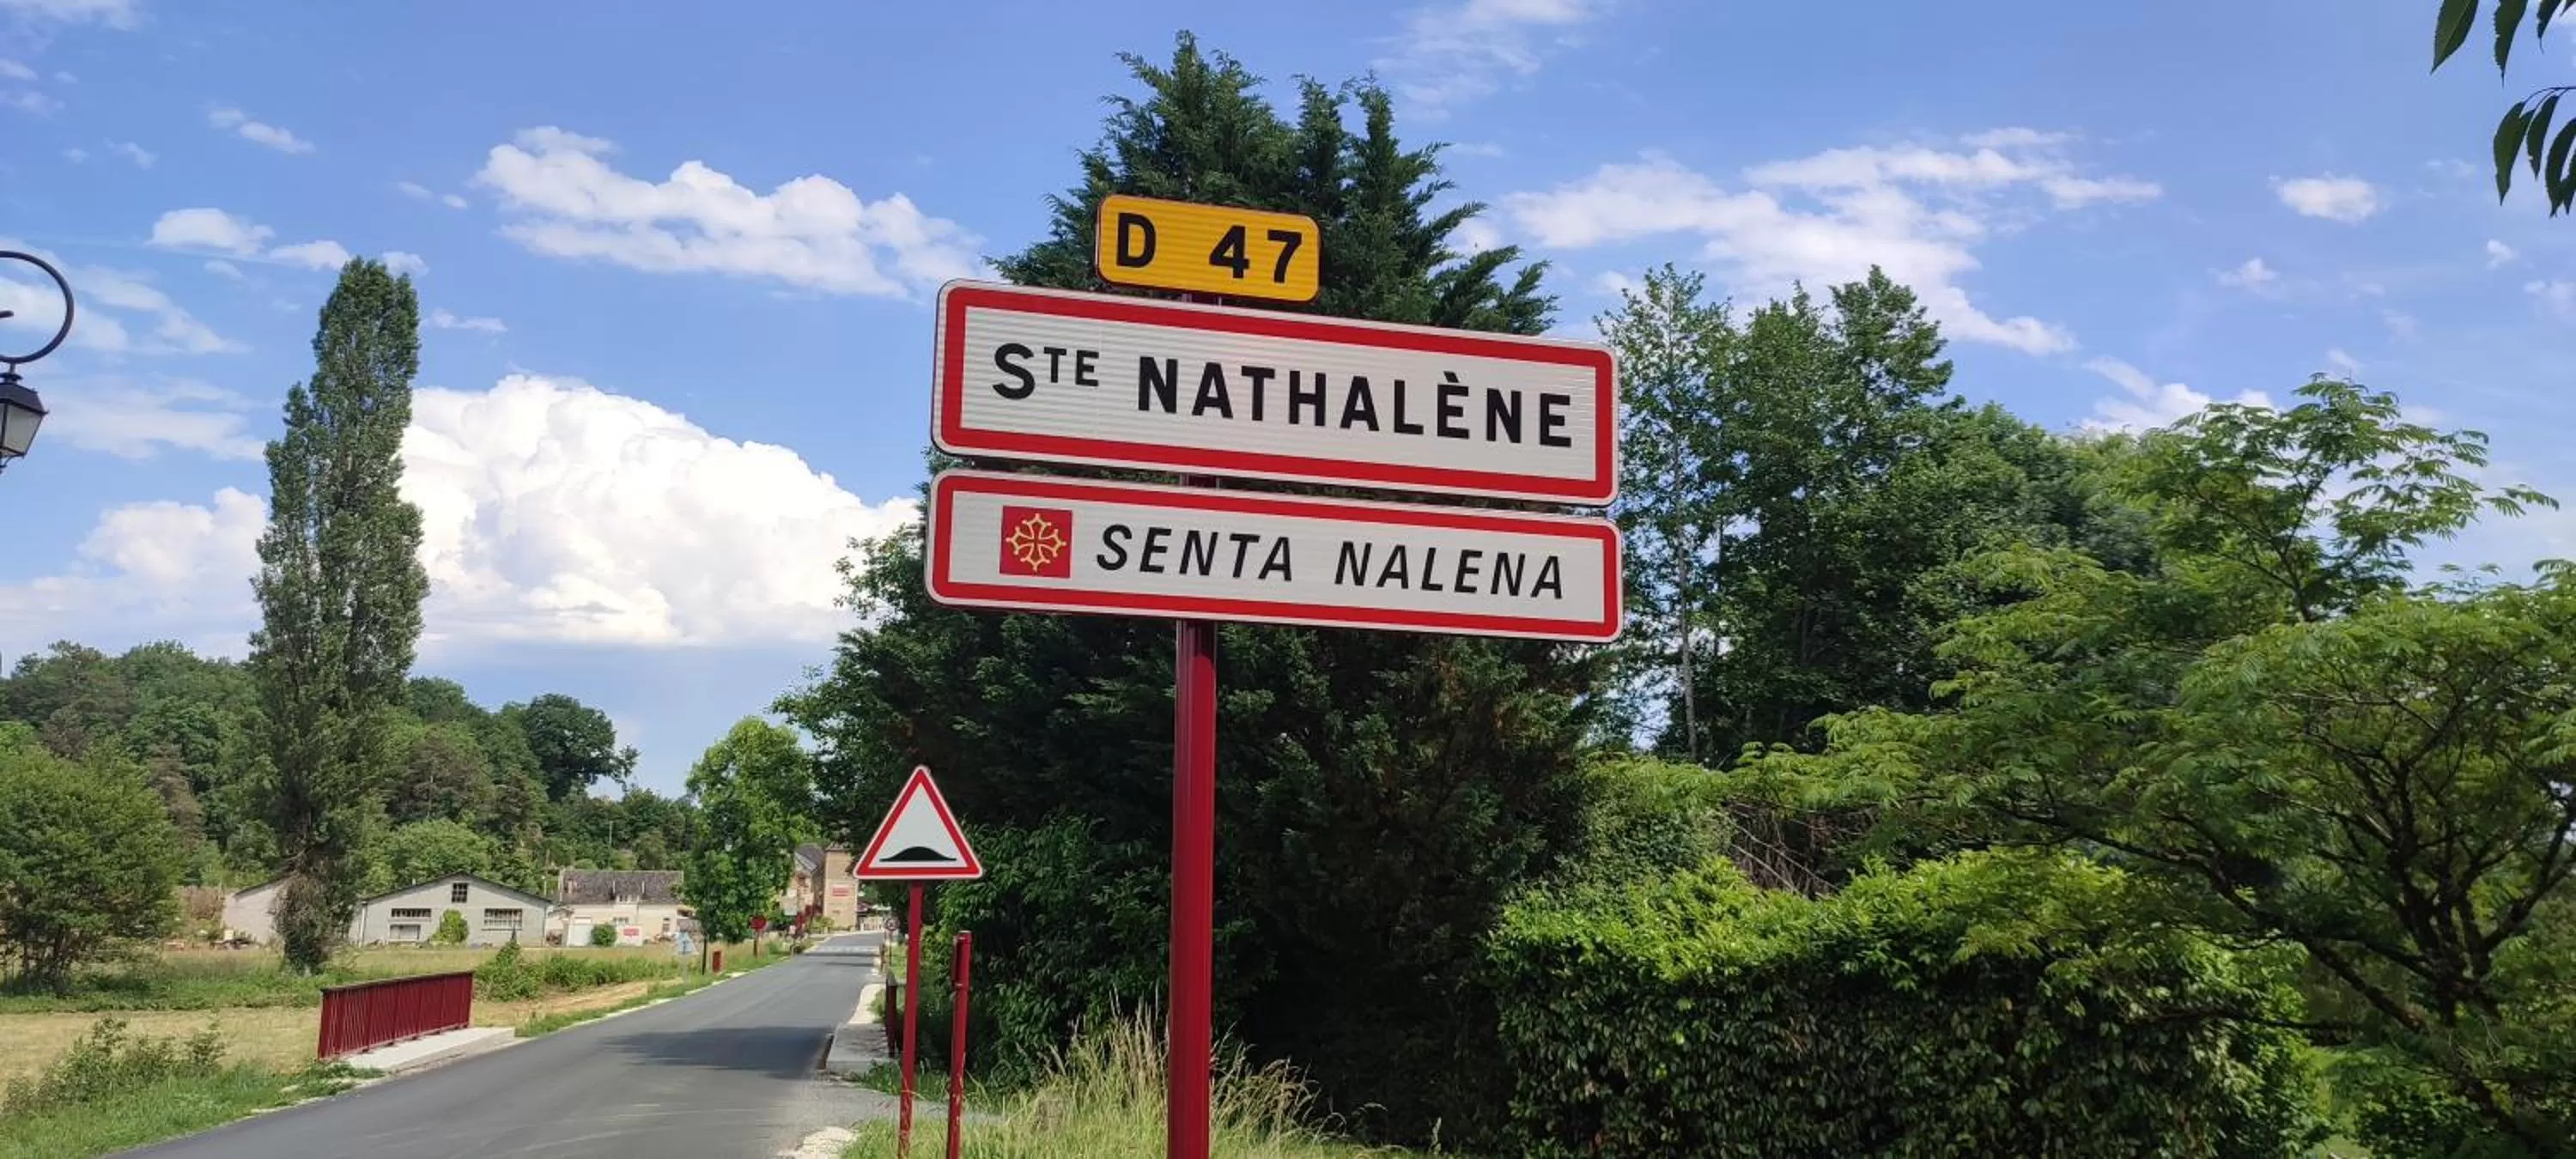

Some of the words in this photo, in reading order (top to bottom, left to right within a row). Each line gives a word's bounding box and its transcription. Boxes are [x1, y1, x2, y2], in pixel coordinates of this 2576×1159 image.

[1115, 212, 1157, 269] D
[1209, 225, 1303, 283] 47
[992, 343, 1100, 401] STE
[1138, 355, 1572, 448] NATHALÈNE
[1096, 524, 1292, 582] SENTA
[1334, 541, 1562, 600] NALENA
